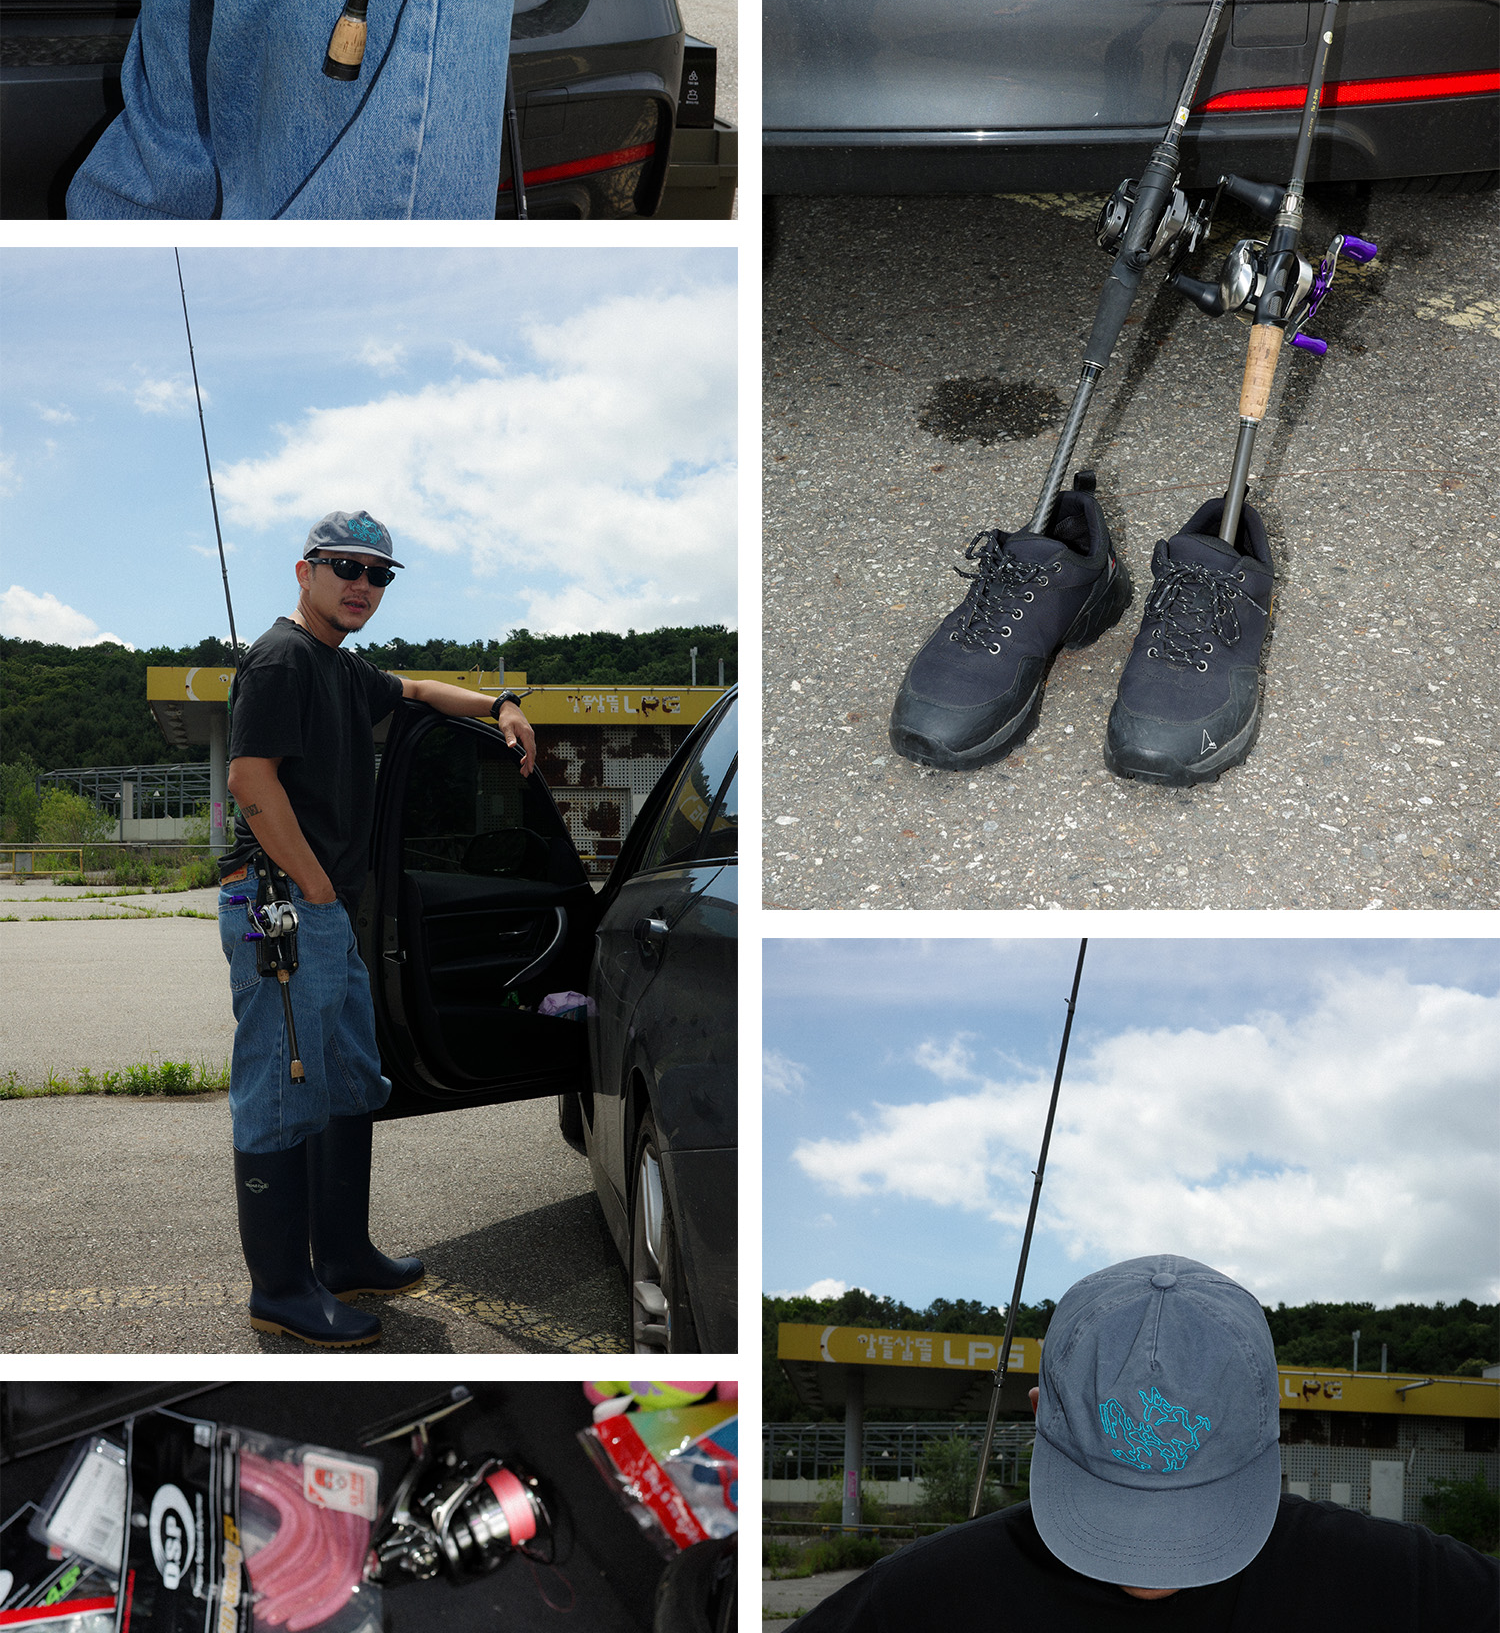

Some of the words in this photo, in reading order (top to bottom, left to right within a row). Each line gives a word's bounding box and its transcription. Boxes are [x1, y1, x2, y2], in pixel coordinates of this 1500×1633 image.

[624, 695, 681, 717] LPG
[943, 1340, 1025, 1369] LPG
[1285, 1379, 1342, 1402] LPG
